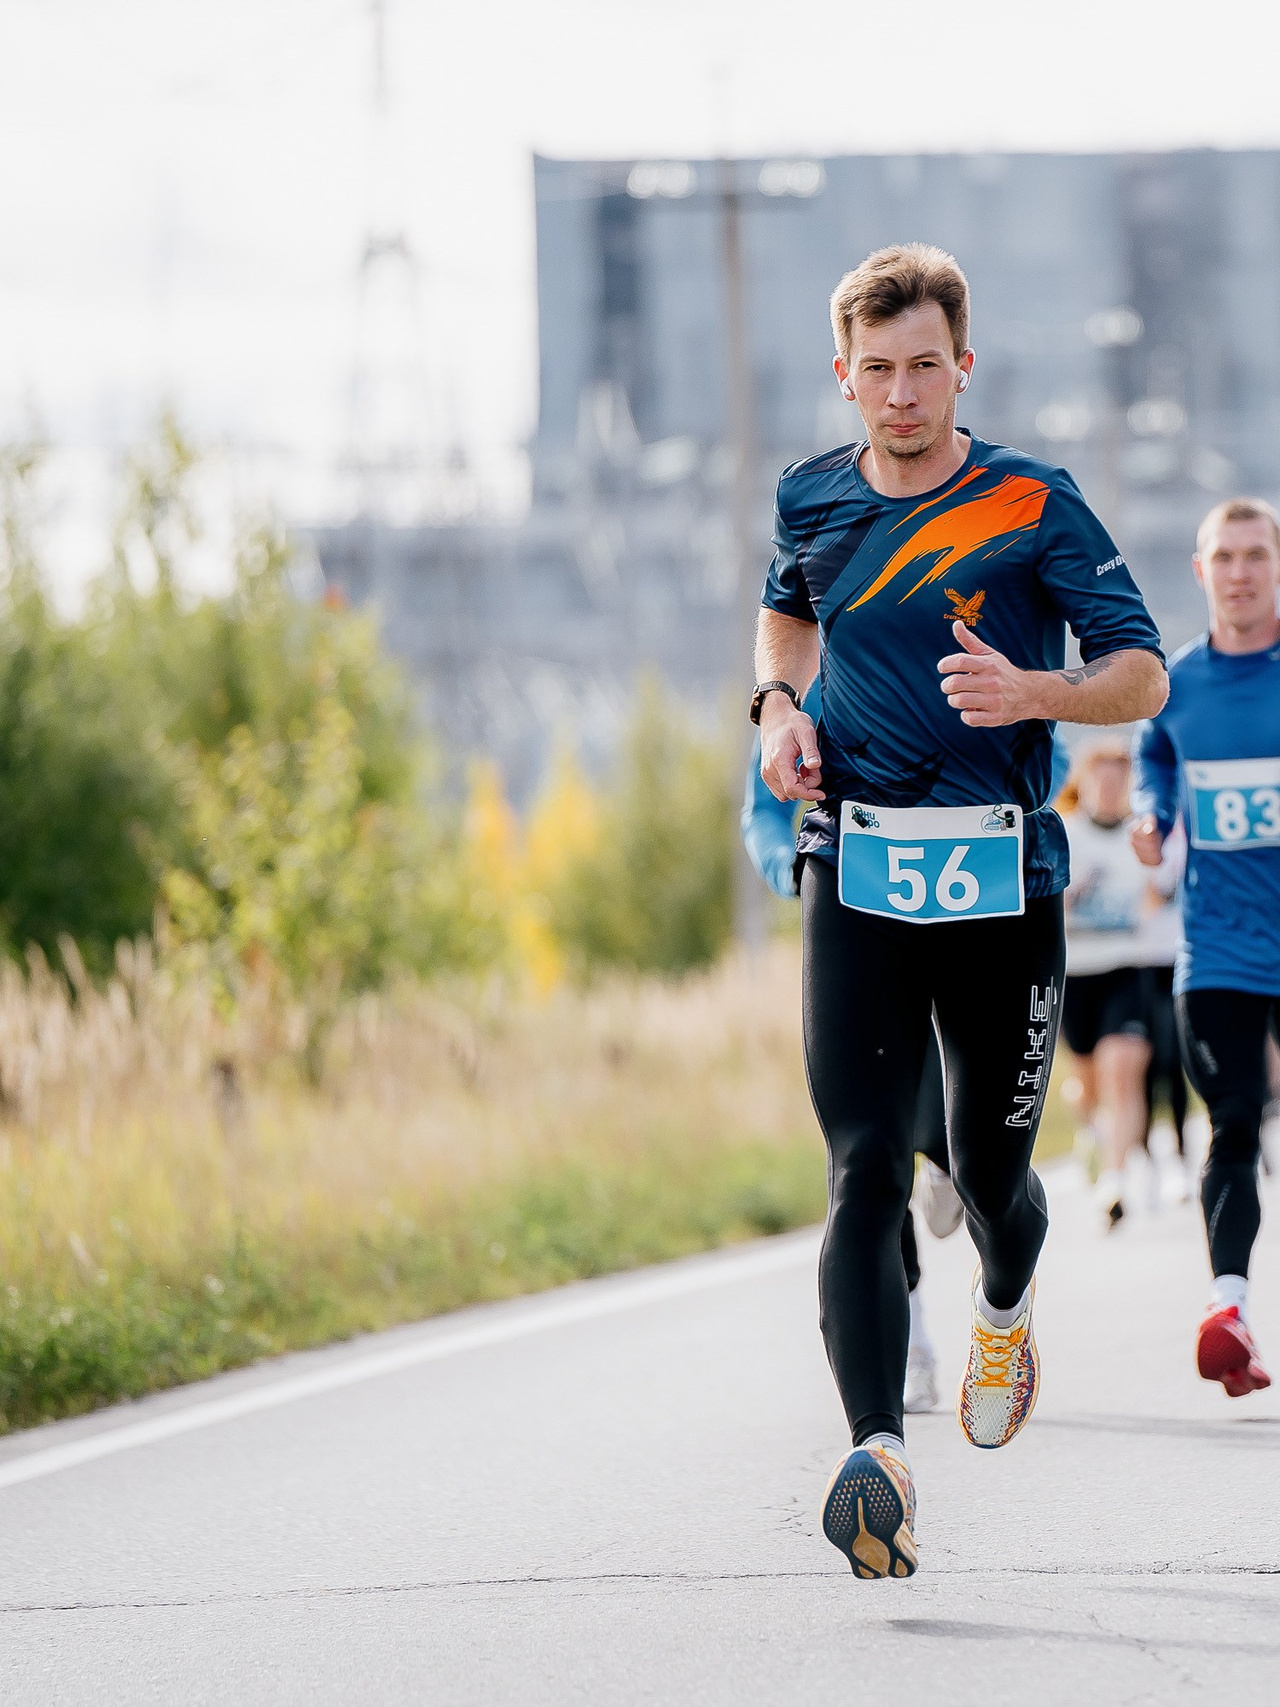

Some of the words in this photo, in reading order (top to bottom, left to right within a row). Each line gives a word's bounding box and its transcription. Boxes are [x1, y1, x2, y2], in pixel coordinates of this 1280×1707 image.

[1096, 559, 1115, 576] Crazy
[887, 845, 980, 912] 56
[1005, 985, 1051, 1127] NIKE
